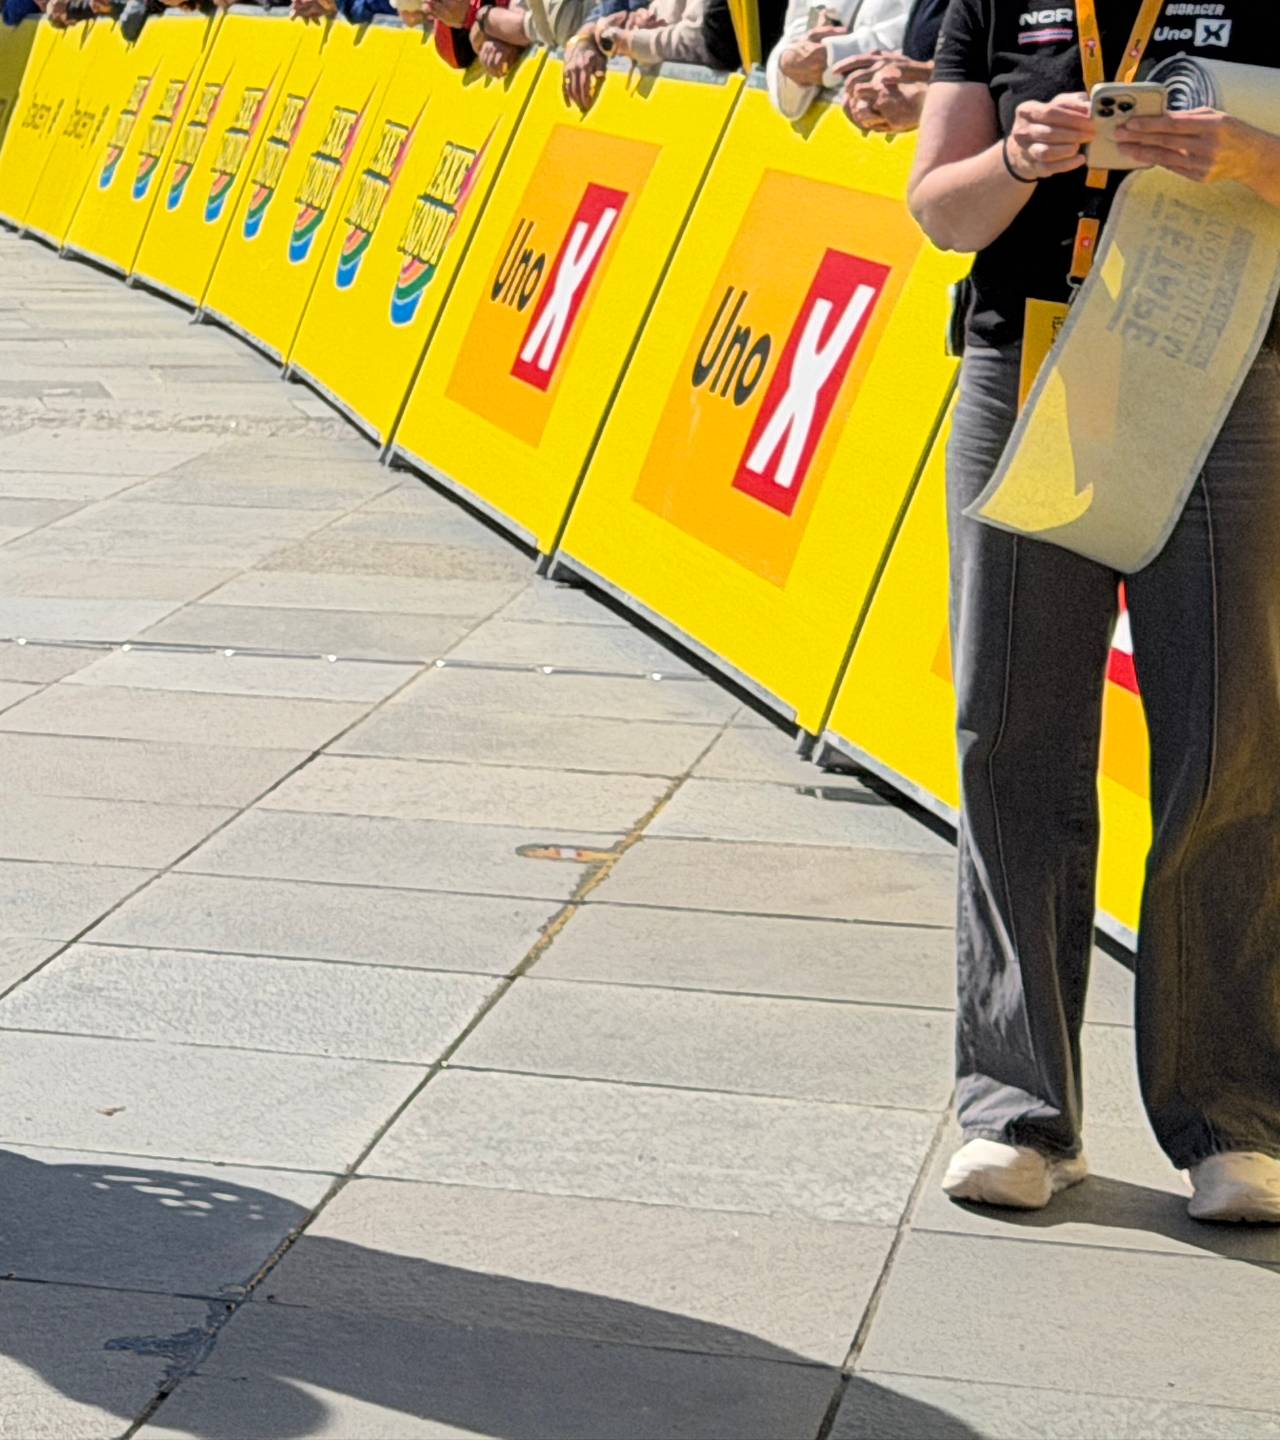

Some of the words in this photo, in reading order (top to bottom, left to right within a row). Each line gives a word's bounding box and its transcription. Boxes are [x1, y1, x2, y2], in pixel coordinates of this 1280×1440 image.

[1019, 8, 1074, 26] NOR
[1153, 26, 1193, 41] Uno
[1201, 23, 1227, 43] X
[426, 140, 477, 205] FAXE
[397, 194, 458, 267] KONDI
[490, 218, 546, 313] Uno
[518, 206, 619, 372] X
[691, 285, 772, 407] Uno
[745, 283, 877, 490] X
